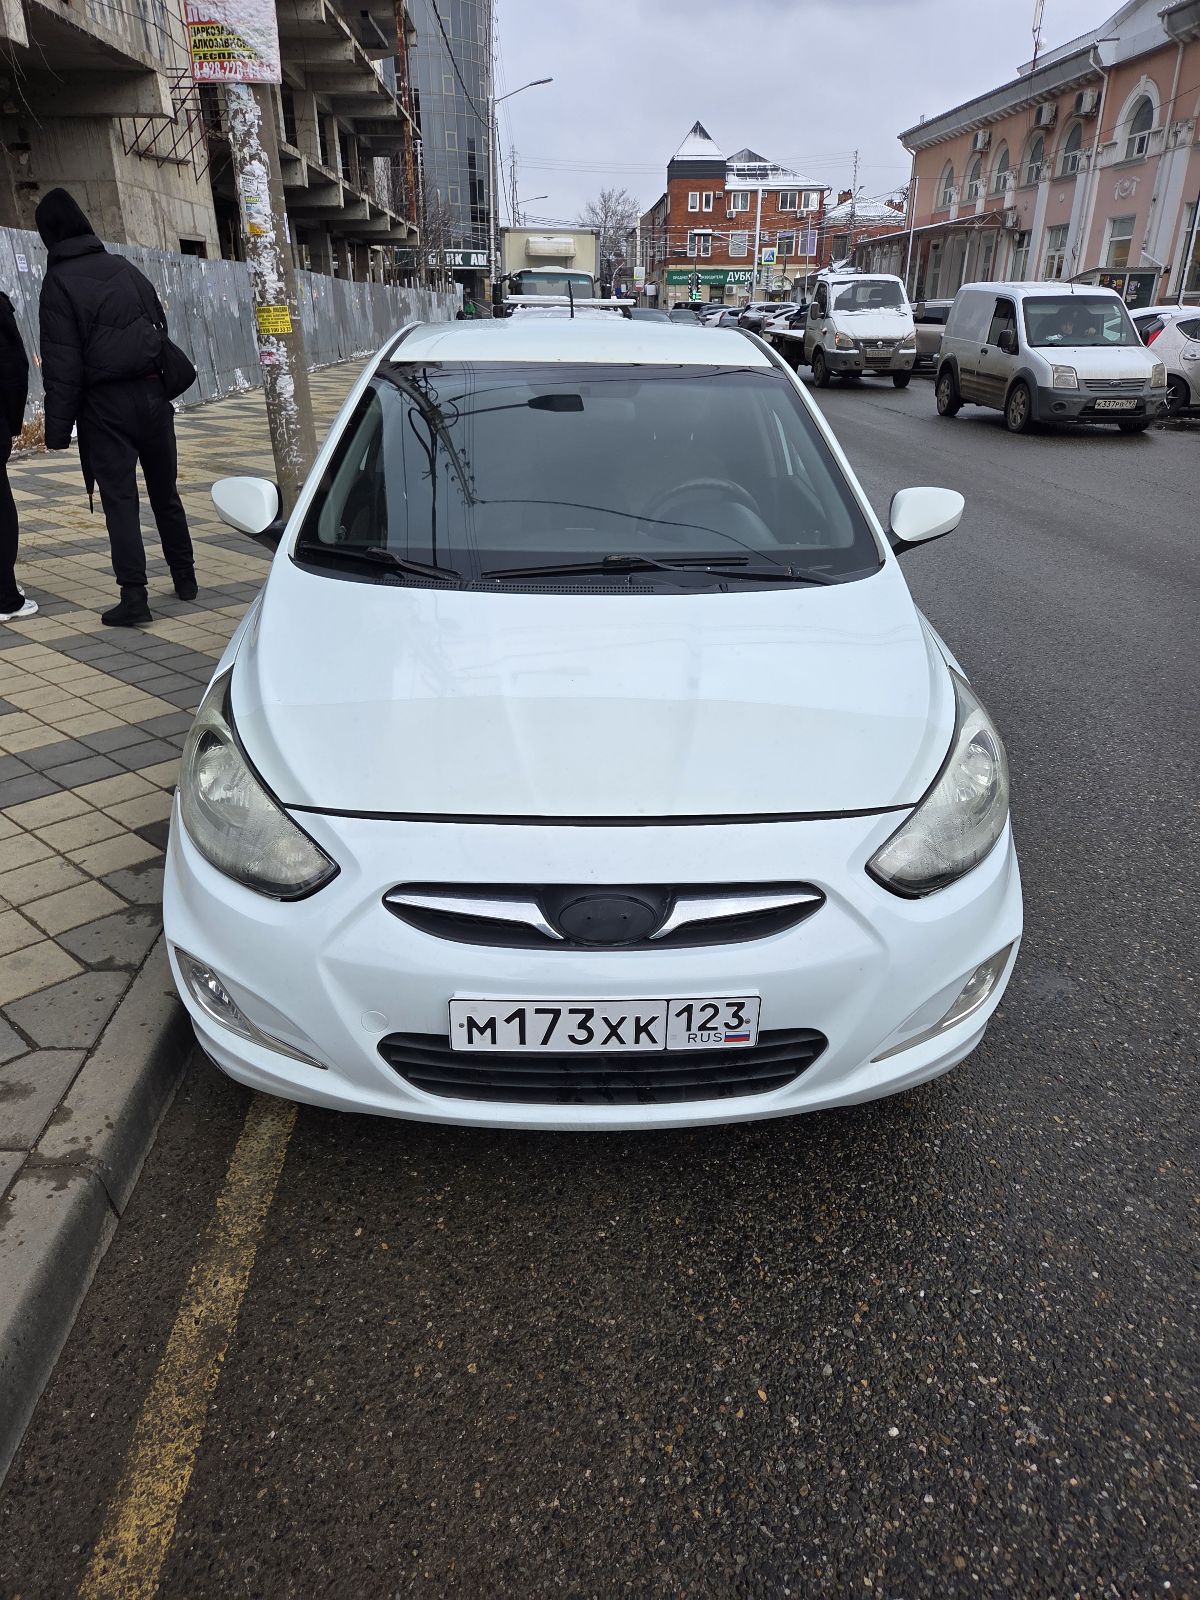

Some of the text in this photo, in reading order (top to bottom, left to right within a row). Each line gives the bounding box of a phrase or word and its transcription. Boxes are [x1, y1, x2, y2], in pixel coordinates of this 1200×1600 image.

[428, 252, 464, 265] БНК
[466, 1001, 746, 1046] М173ХК 123
[687, 1032, 723, 1044] RUS
